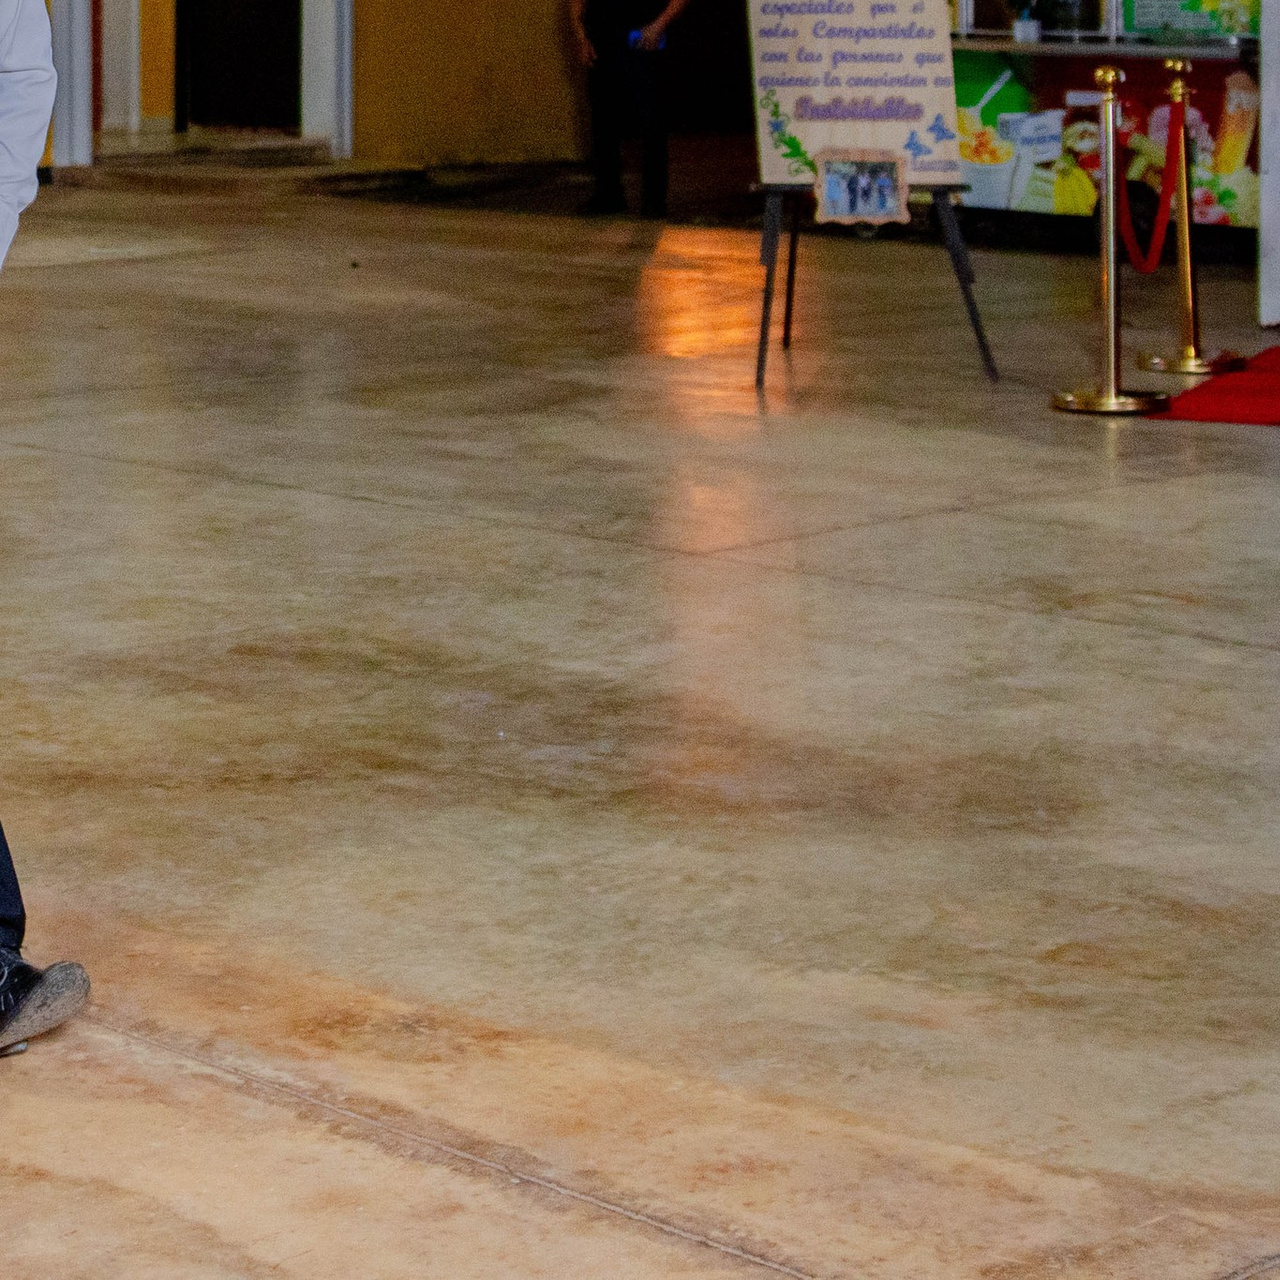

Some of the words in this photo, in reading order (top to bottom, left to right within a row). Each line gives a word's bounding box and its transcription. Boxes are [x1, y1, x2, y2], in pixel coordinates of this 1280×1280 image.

[871, 3, 897, 18] por
[761, 52, 789, 63] con
[796, 46, 822, 63] las
[832, 51, 904, 70] personas
[914, 52, 945, 68] que
